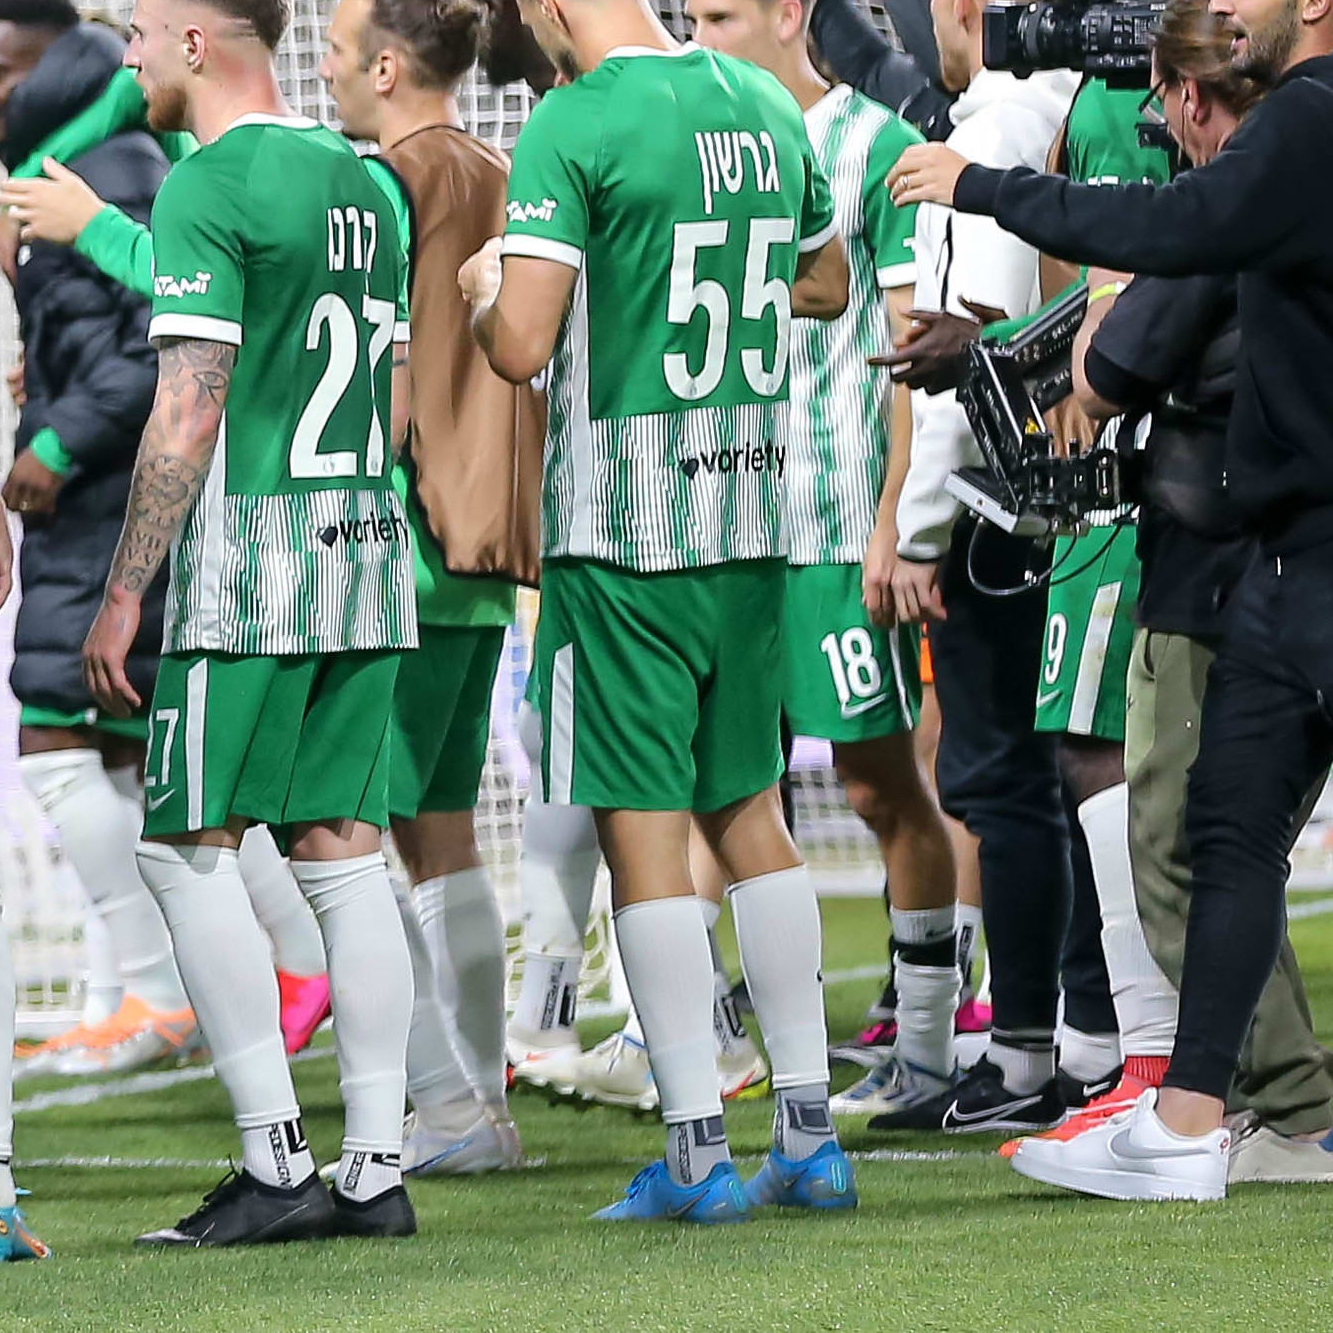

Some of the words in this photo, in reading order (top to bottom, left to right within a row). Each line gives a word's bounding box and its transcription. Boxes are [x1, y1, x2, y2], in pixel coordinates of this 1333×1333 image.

[694, 130, 781, 215] גרשון
[663, 217, 796, 401] 55
[289, 293, 397, 479] 27
[700, 438, 786, 479] variety
[820, 626, 883, 706] 18
